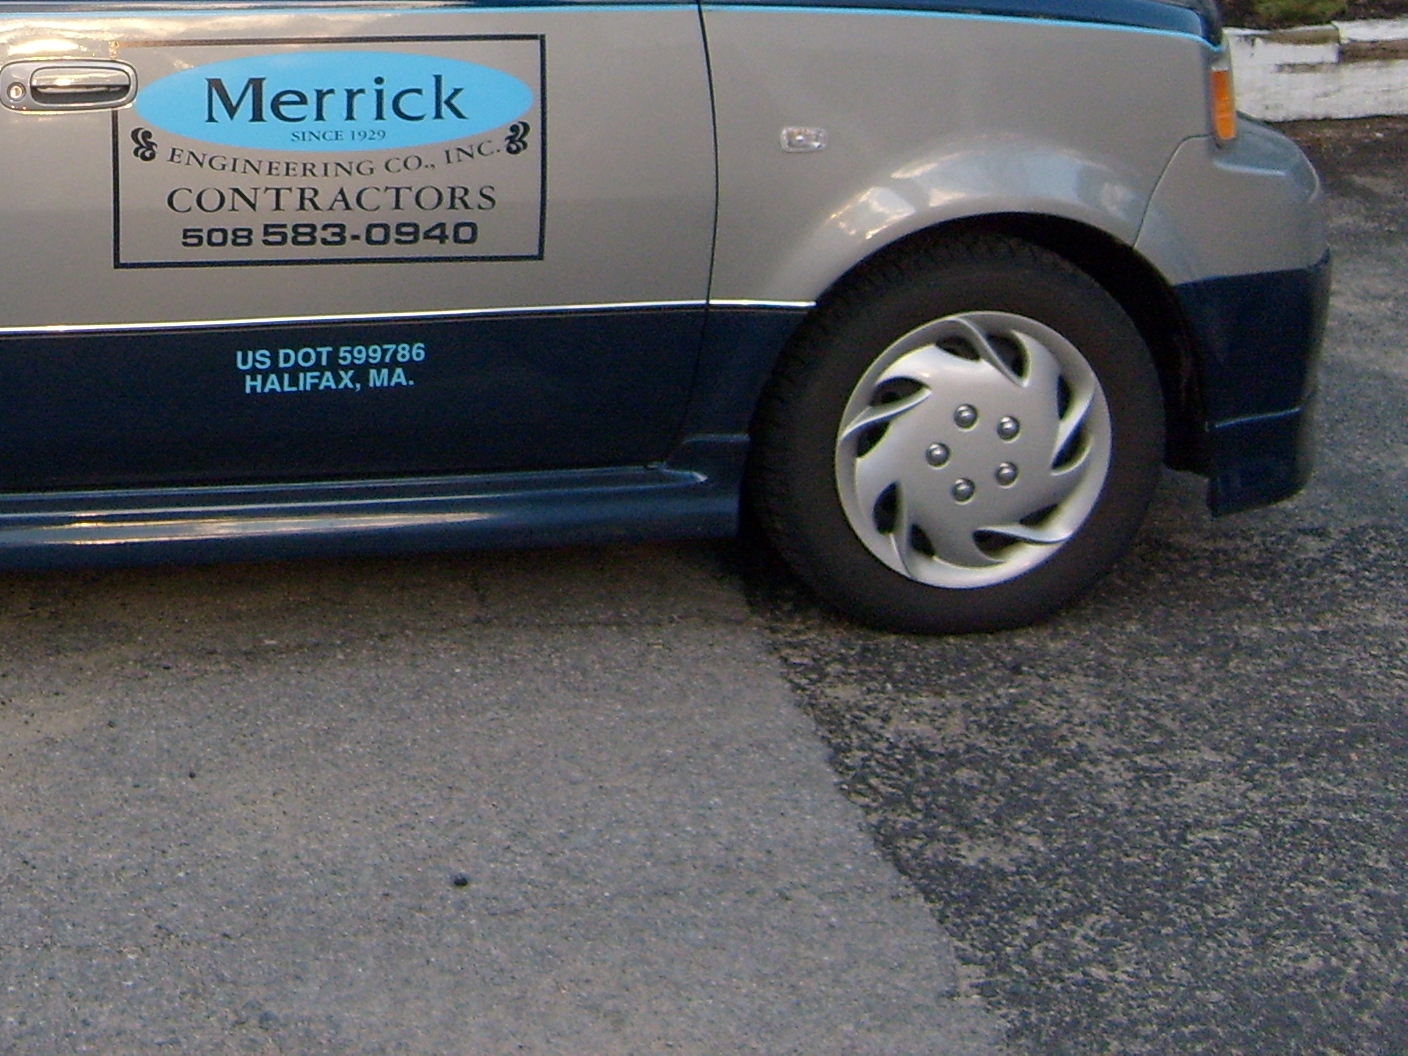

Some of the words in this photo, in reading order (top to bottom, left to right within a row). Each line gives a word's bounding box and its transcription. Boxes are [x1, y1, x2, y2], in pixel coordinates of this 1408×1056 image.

[205, 74, 468, 124] Merrick
[291, 130, 344, 142] SINCE
[349, 129, 387, 141] 1929
[167, 147, 376, 178] ENGINEERING
[384, 155, 436, 175] CO.,
[445, 140, 502, 165] INC.
[167, 185, 497, 214] CONTRACTORS
[181, 227, 254, 247] 508
[261, 221, 479, 246] 583-0940
[236, 350, 271, 371] US
[278, 347, 333, 368] DOT
[338, 343, 425, 365] 599786
[245, 370, 361, 394] HALIFAX,
[369, 368, 414, 388] MA.
